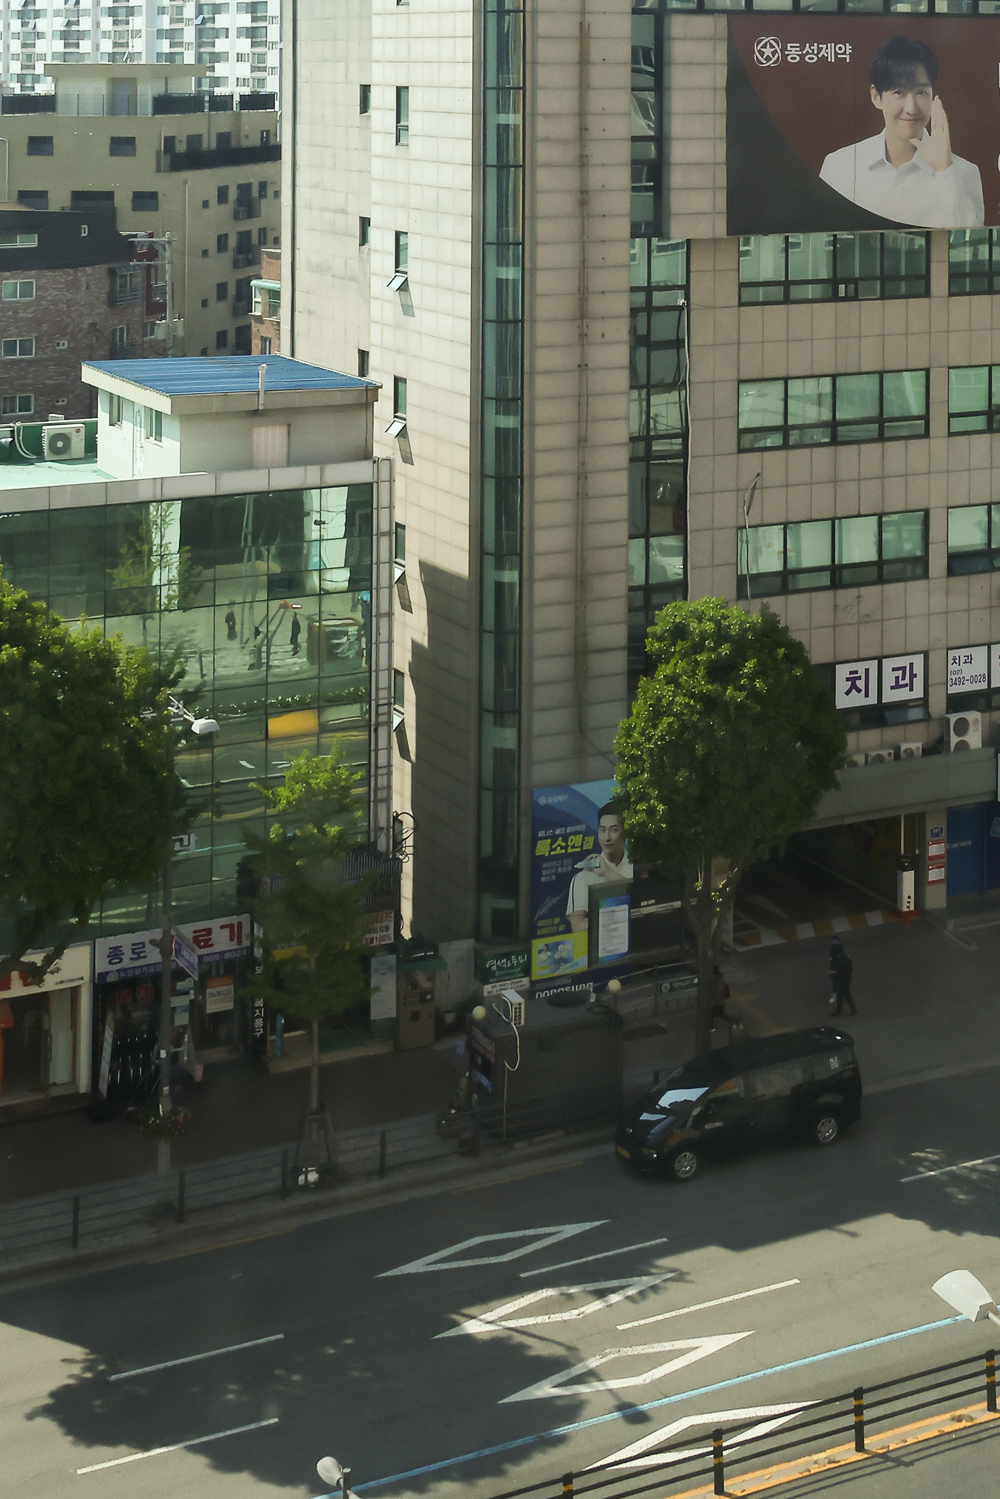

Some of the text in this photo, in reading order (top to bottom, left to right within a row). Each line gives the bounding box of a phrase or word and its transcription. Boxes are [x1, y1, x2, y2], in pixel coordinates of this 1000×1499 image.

[784, 41, 853, 64] 동성제약
[951, 654, 974, 667] 치과
[844, 661, 918, 699] 치과
[107, 941, 147, 965] 종로
